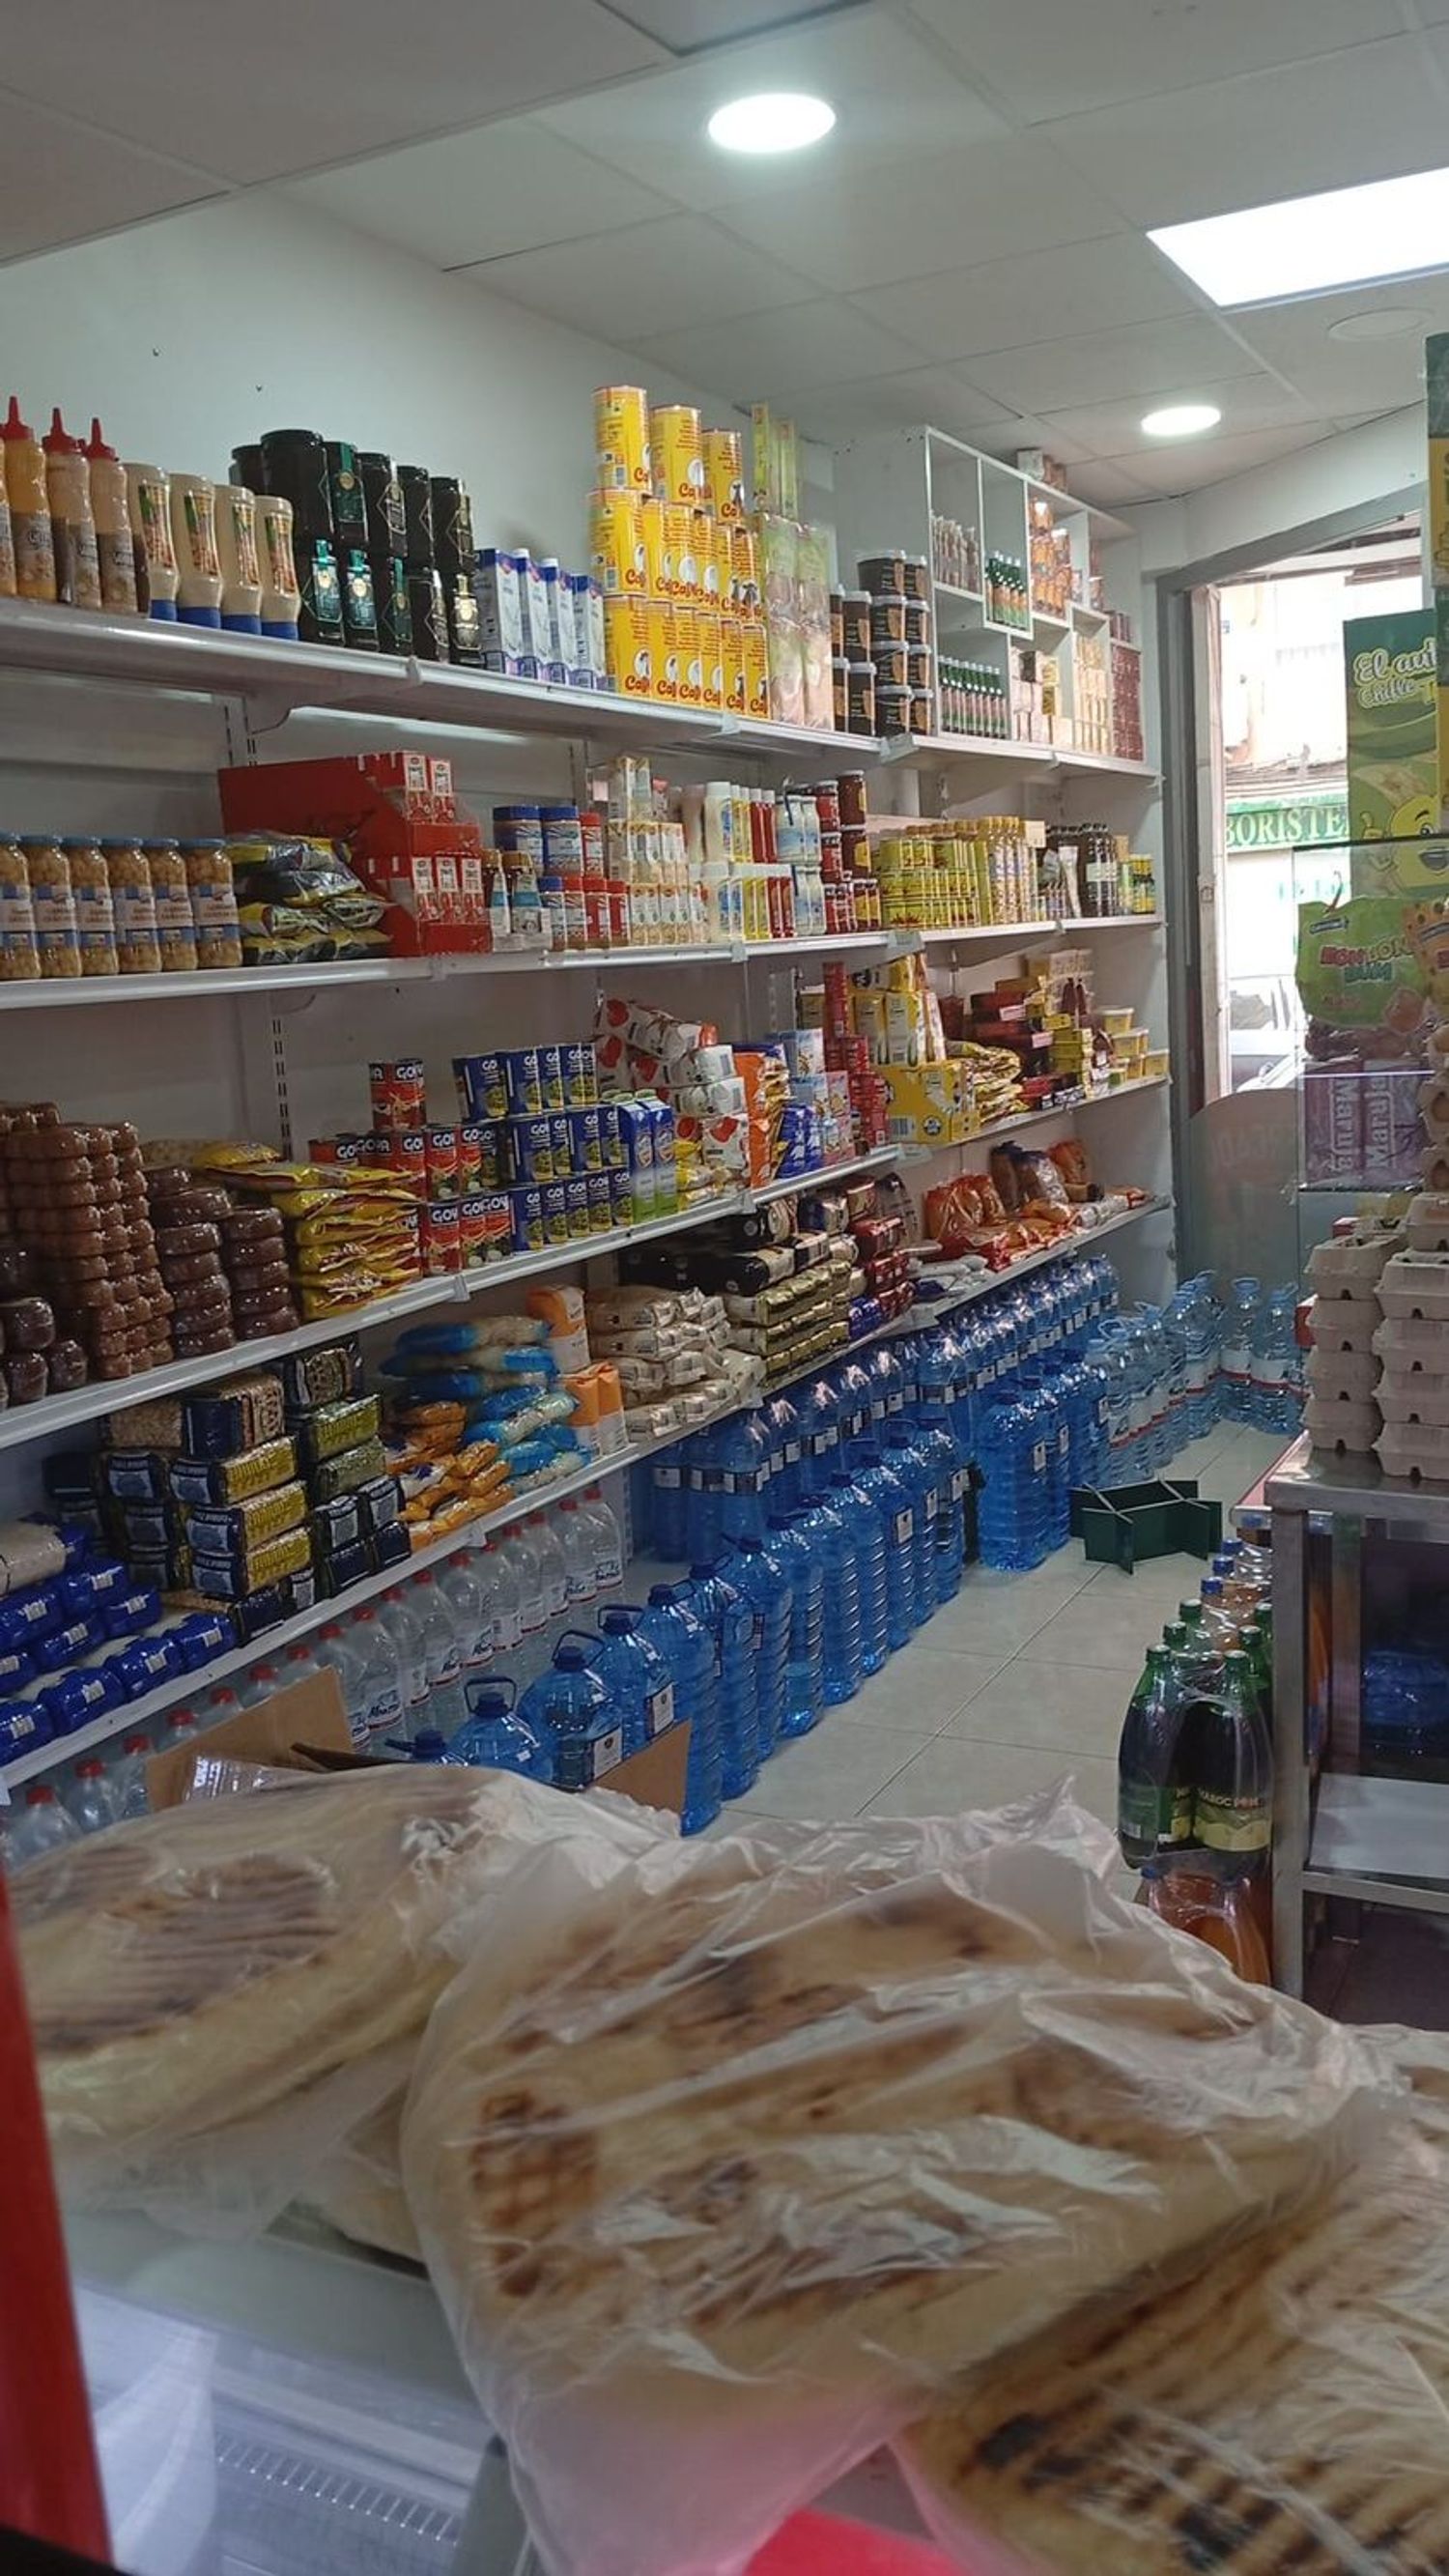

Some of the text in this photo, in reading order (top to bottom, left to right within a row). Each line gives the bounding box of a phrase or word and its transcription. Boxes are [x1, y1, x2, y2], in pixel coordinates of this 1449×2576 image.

[1355, 640, 1436, 683] El aut
[1226, 806, 1349, 846] BORISTE
